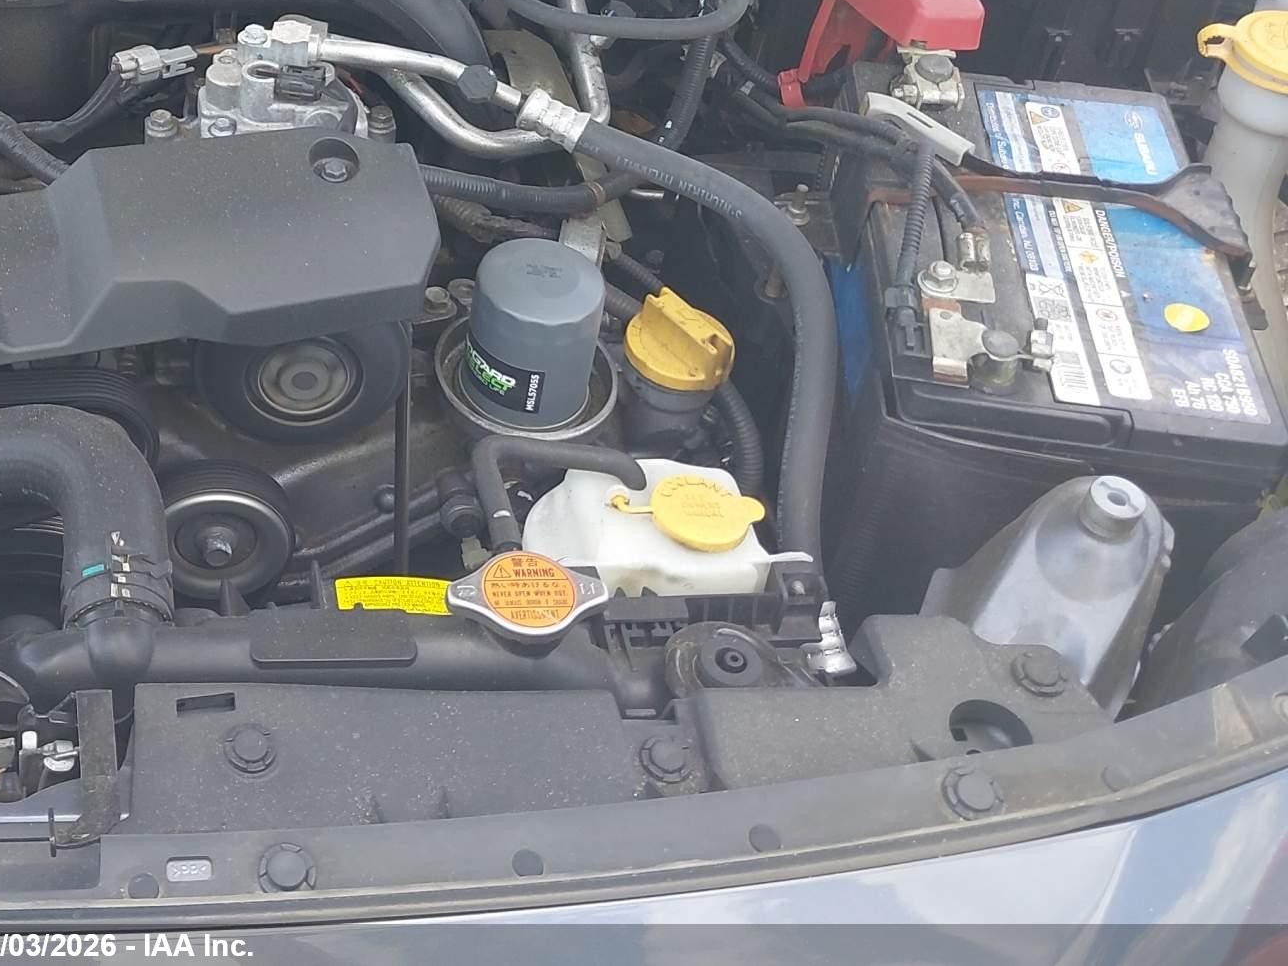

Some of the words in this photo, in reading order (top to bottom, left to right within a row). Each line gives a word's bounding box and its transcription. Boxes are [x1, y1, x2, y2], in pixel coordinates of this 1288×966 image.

[1094, 209, 1127, 278] DANGER/POISON
[1199, 376, 1218, 392] RC
[1214, 372, 1235, 393] CCA
[1170, 387, 1191, 408] EFB
[1205, 393, 1225, 413] 120
[512, 568, 556, 579] WARNING
